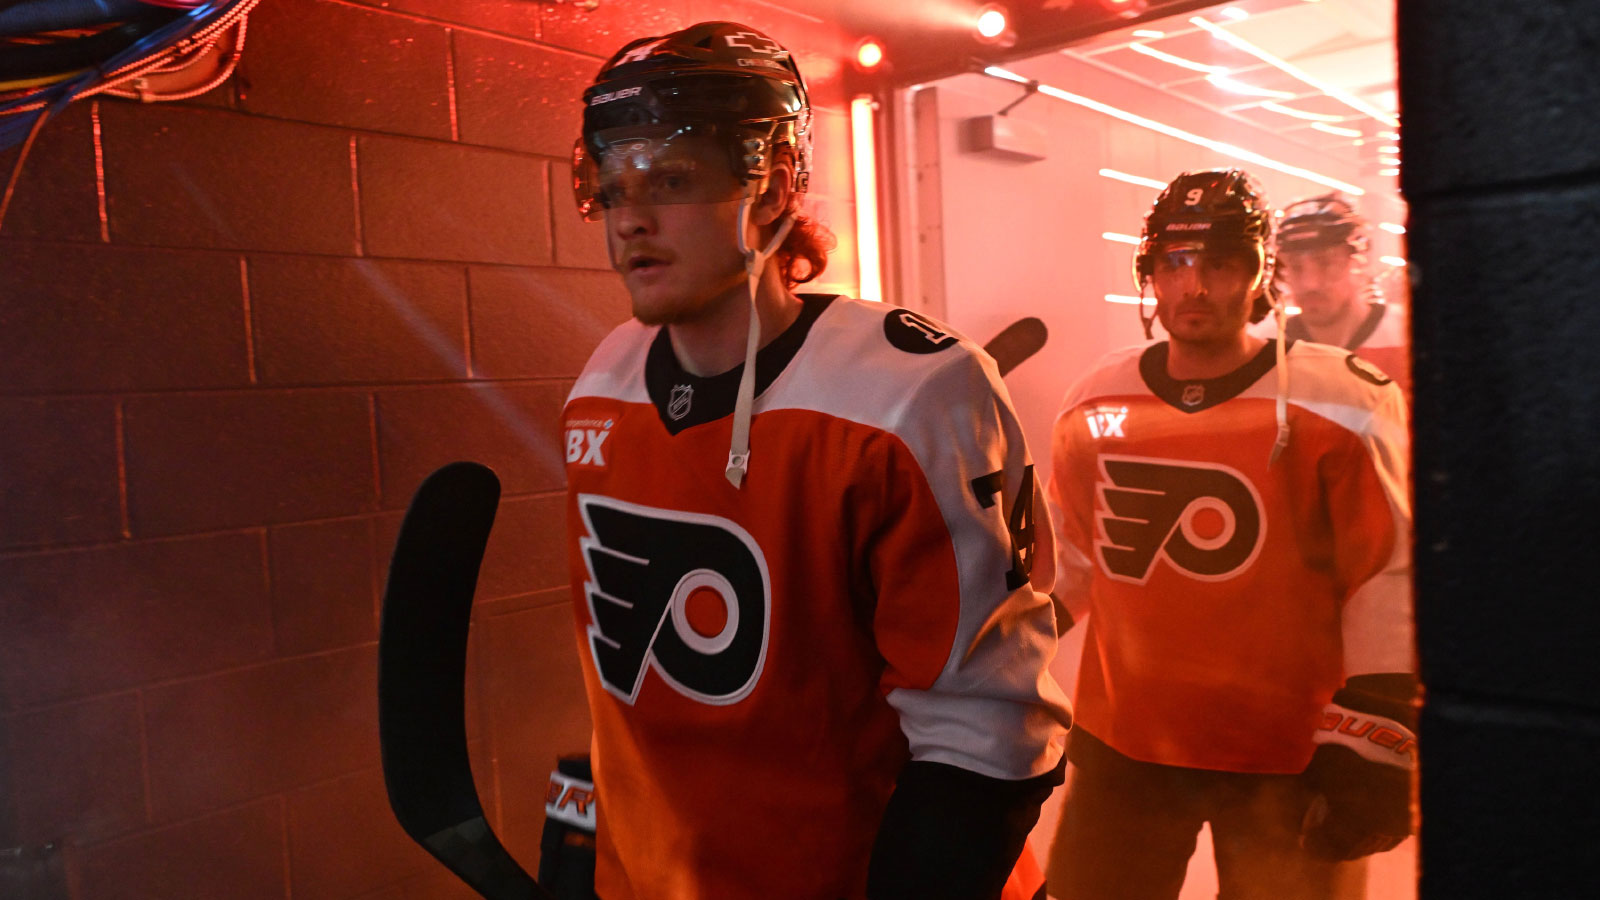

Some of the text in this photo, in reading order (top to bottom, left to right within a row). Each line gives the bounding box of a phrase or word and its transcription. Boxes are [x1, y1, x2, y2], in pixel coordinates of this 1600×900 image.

[590, 86, 642, 106] BAUER
[1184, 188, 1204, 206] 9
[564, 429, 610, 467] BX
[971, 463, 1036, 592] 74
